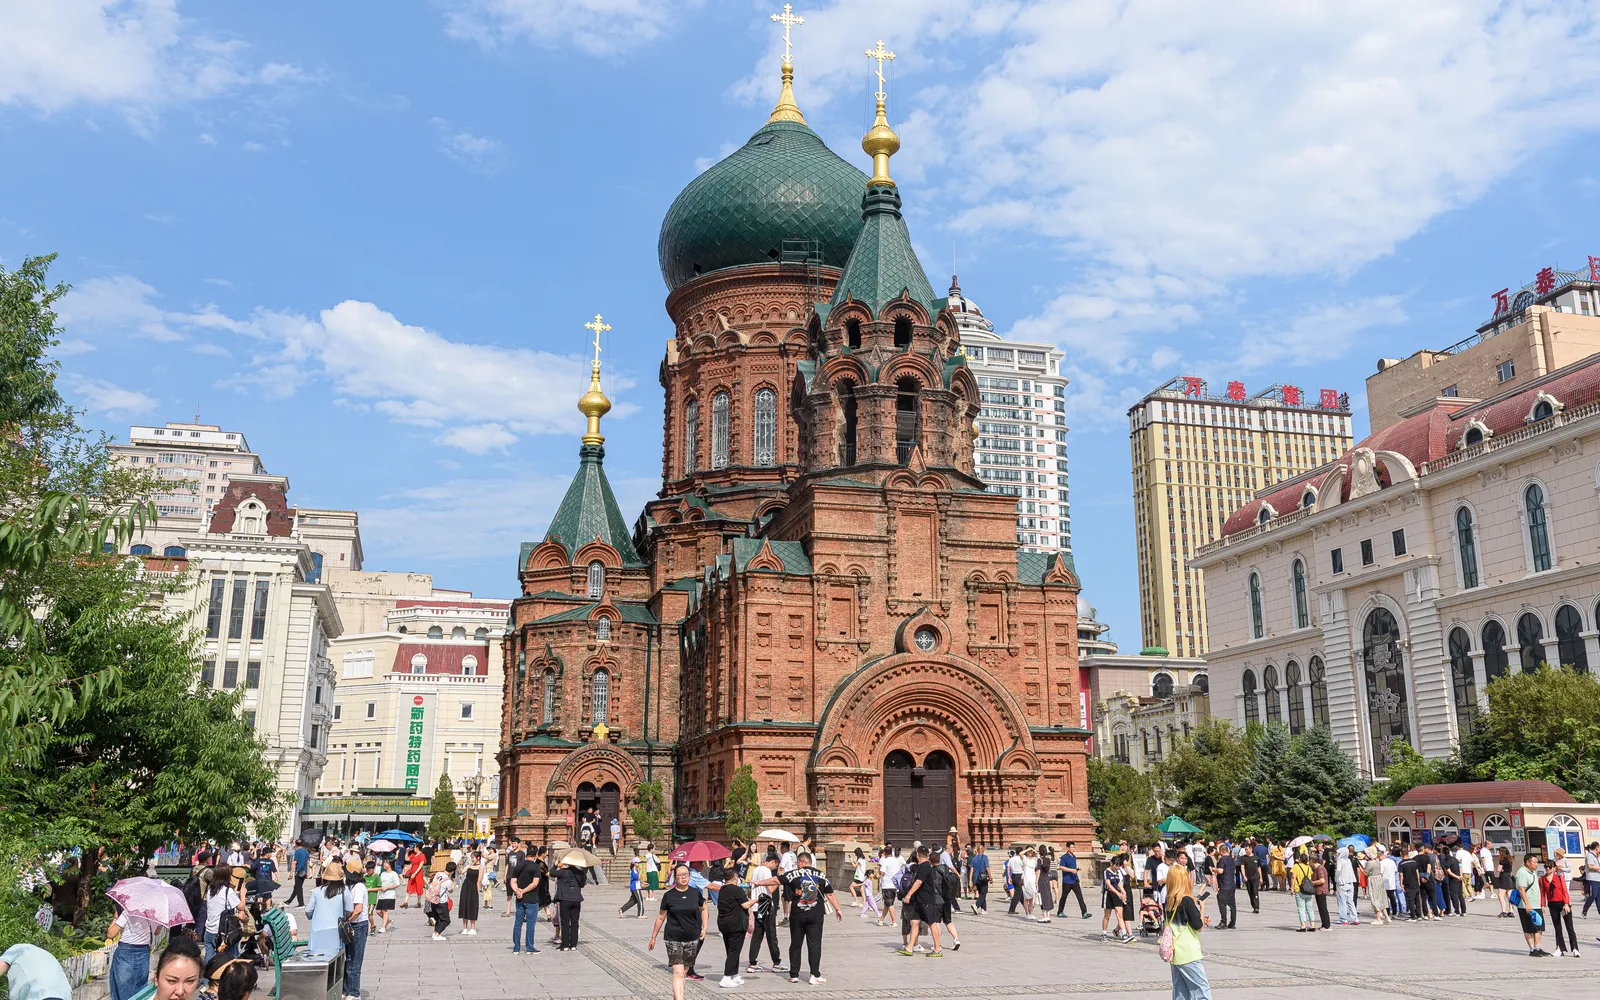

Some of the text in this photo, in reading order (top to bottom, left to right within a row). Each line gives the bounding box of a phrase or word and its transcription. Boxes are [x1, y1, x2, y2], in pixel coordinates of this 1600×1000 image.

[1183, 376, 1339, 409] 万泰集团
[405, 706, 425, 790] 新药特药商店
